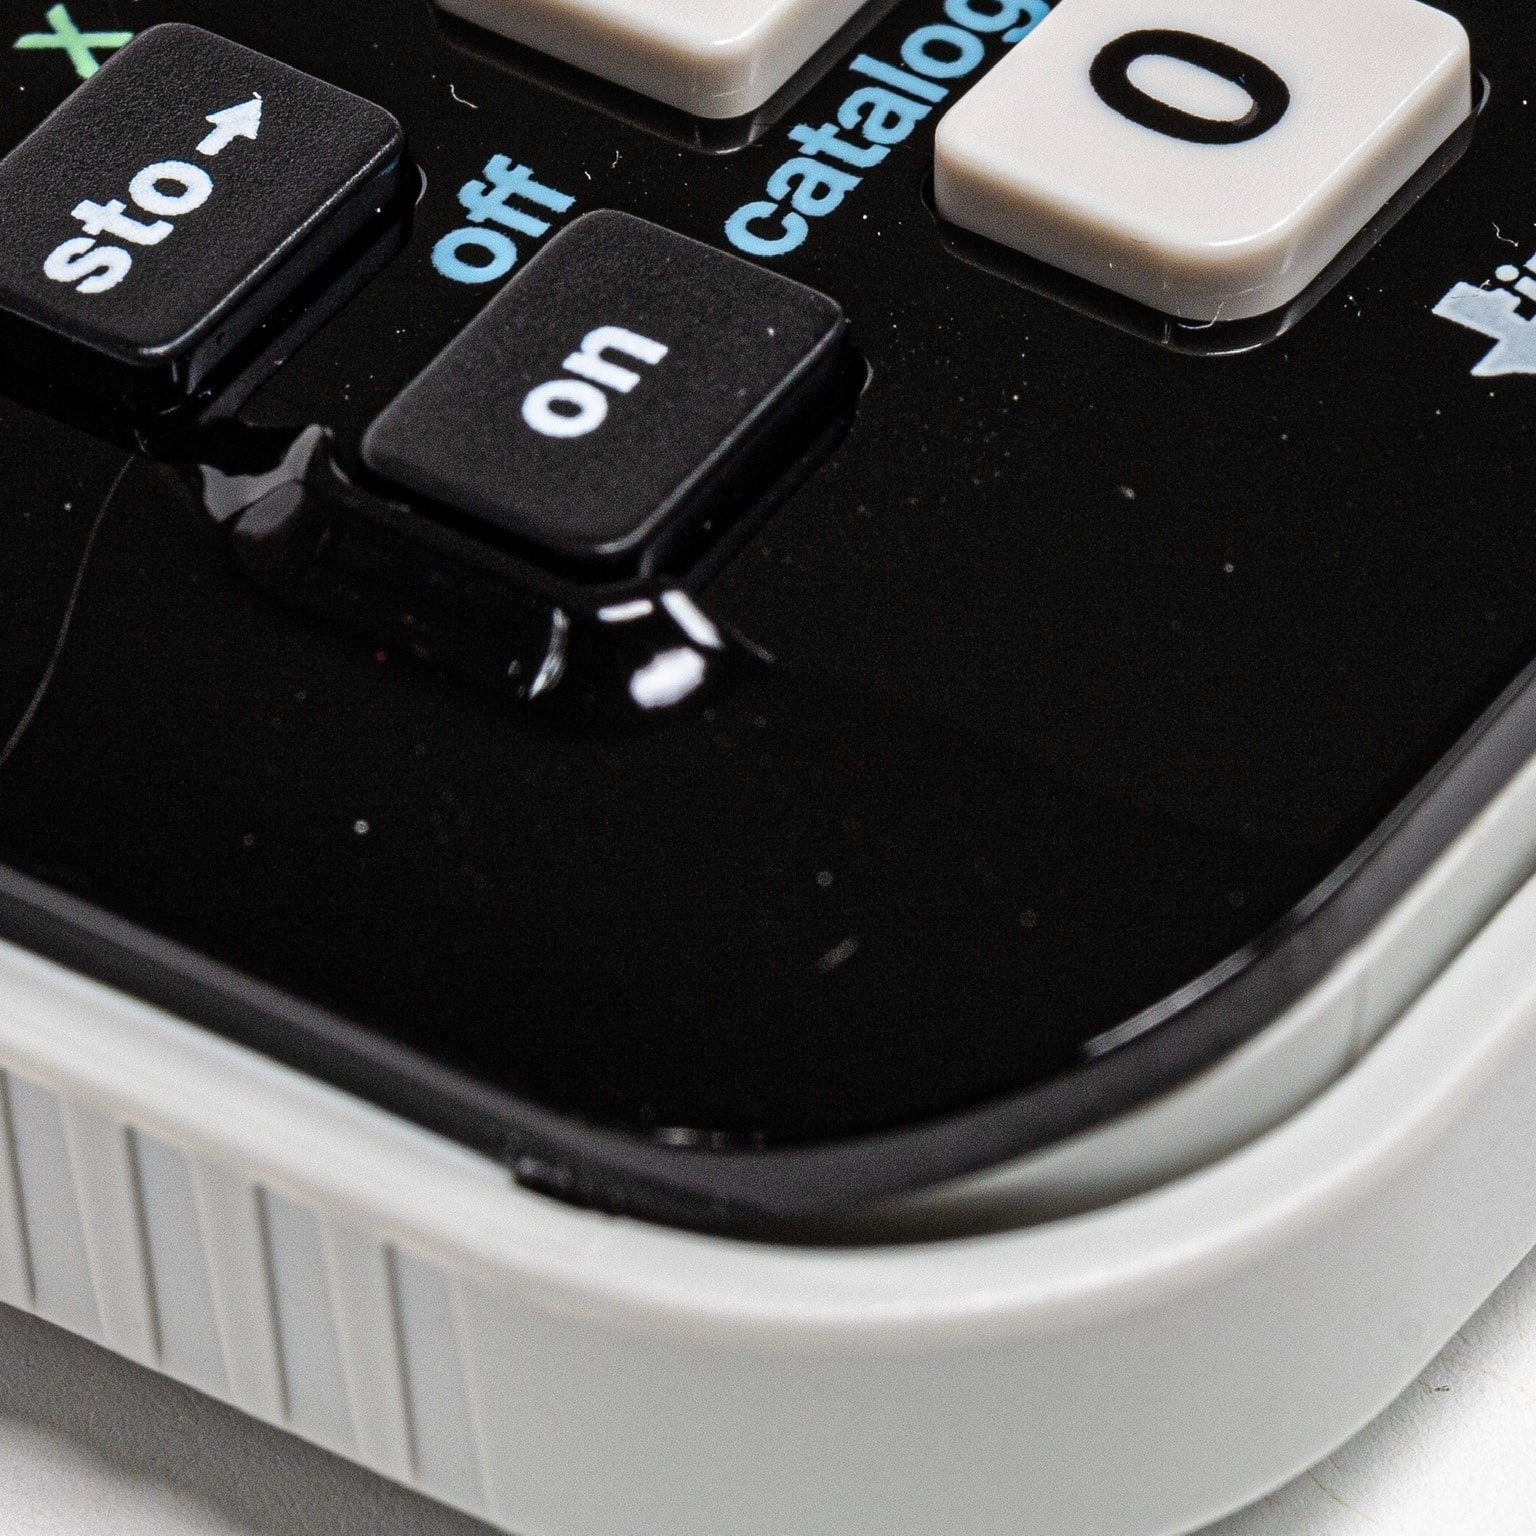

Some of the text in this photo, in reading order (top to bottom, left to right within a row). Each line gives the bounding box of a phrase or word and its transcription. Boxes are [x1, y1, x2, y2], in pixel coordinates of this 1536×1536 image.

[19, 8, 130, 78] X
[1088, 29, 1291, 146] 0
[431, 154, 574, 284] off
[522, 326, 668, 438] on
